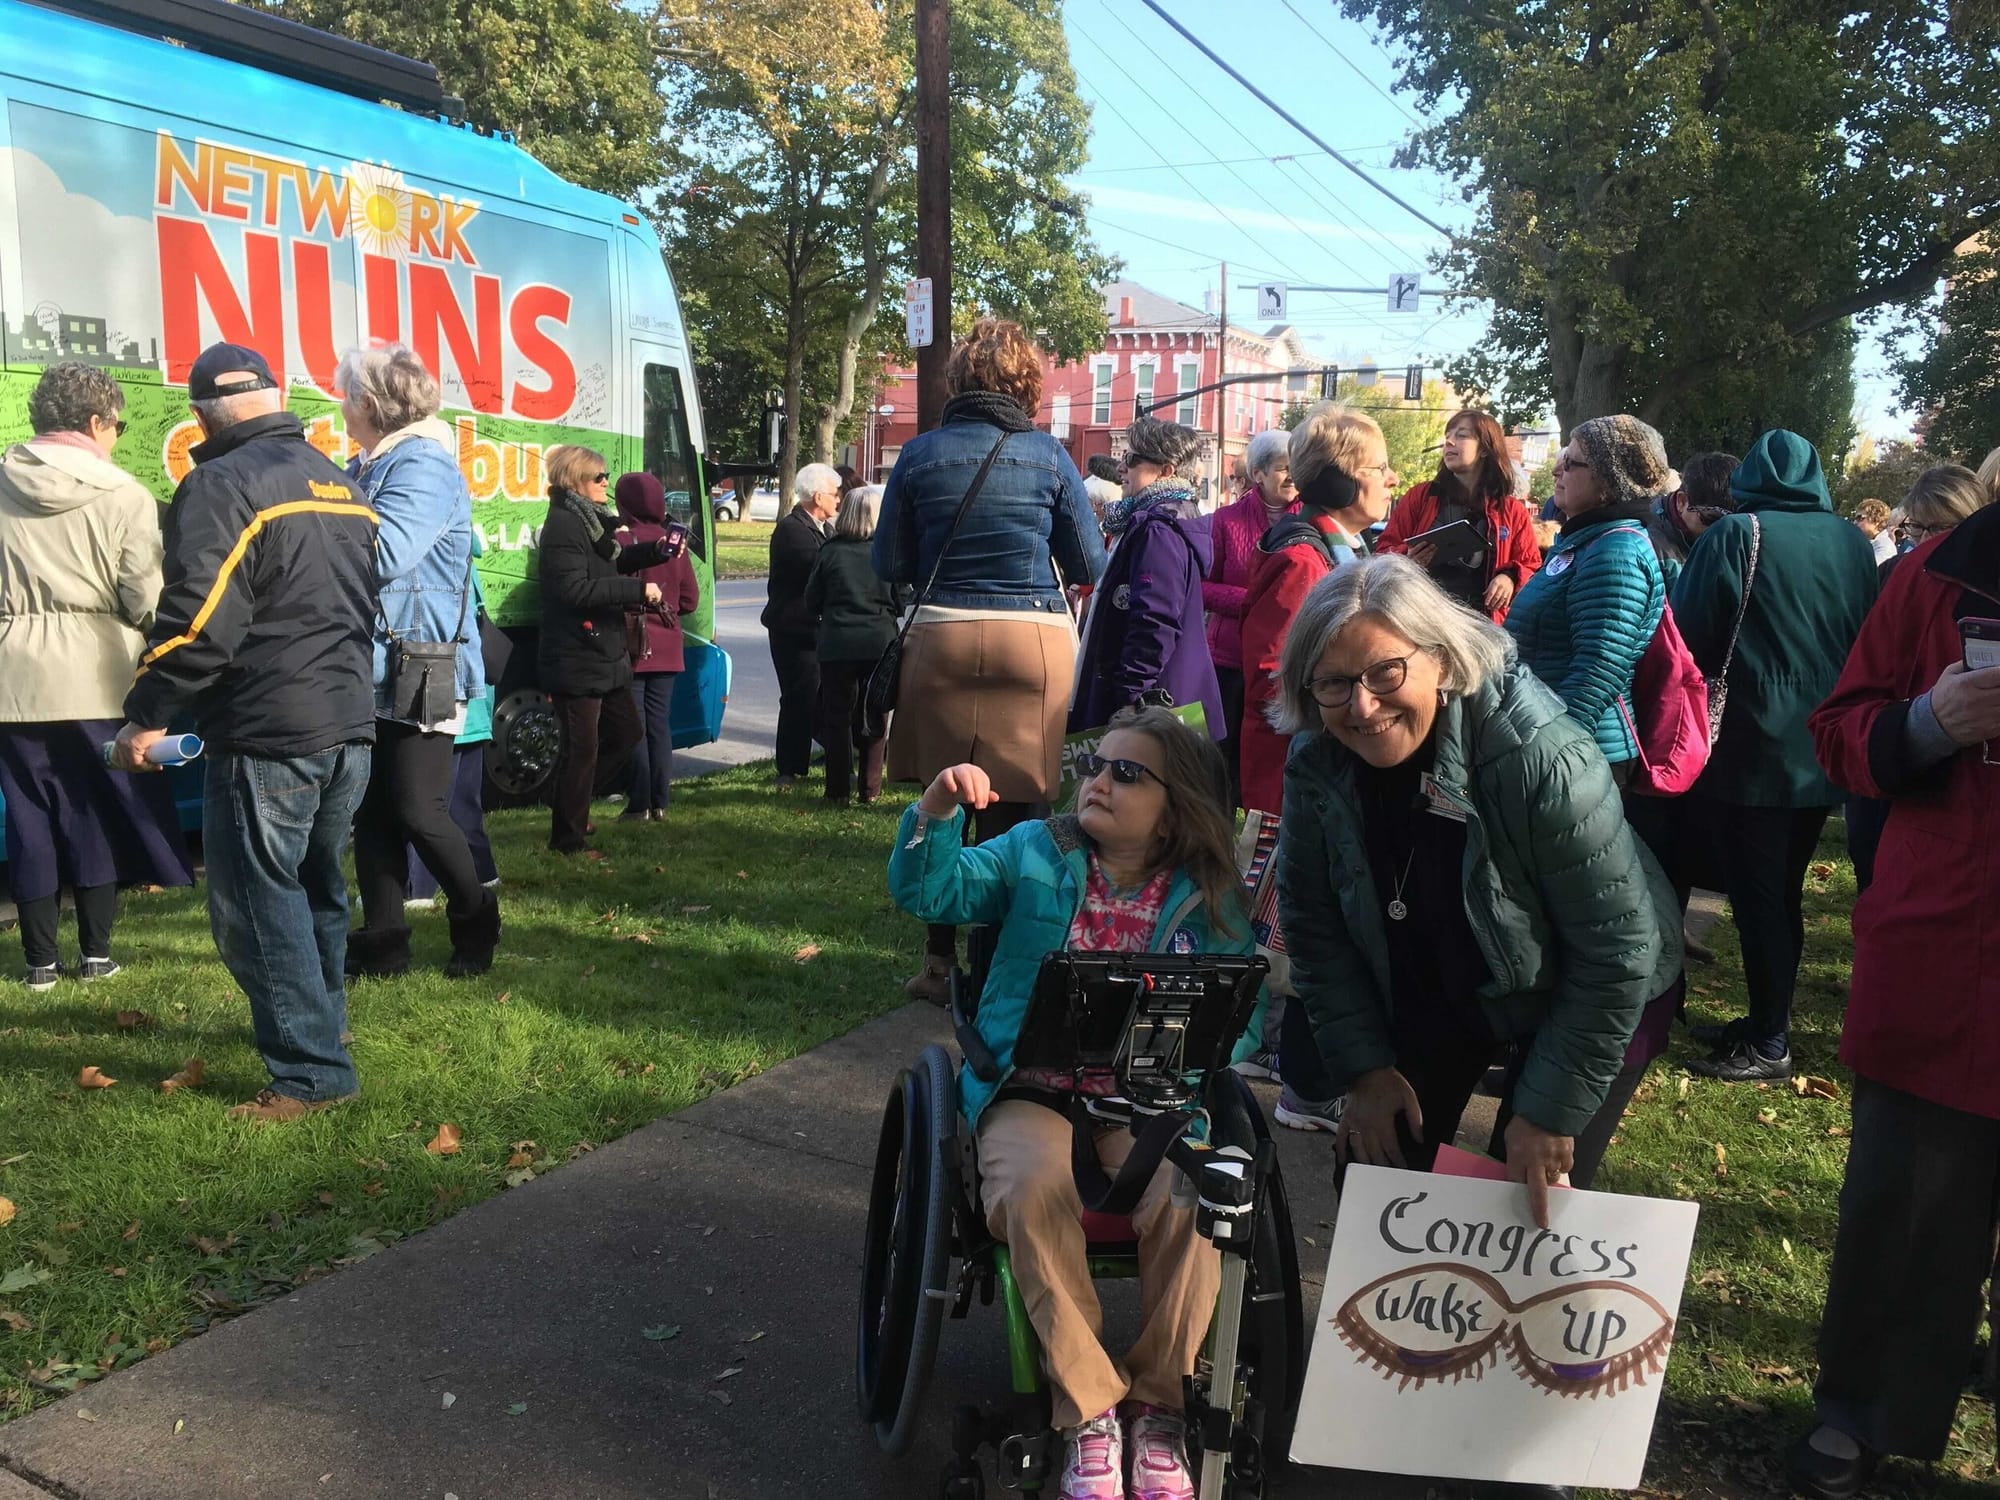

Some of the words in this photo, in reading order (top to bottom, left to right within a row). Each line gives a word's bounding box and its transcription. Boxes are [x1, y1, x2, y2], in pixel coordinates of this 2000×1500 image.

[156, 216, 577, 420] NUNS
[1262, 308, 1282, 317] ONLY
[1379, 1191, 1638, 1278] Congress
[1375, 1279, 1492, 1344] Wake
